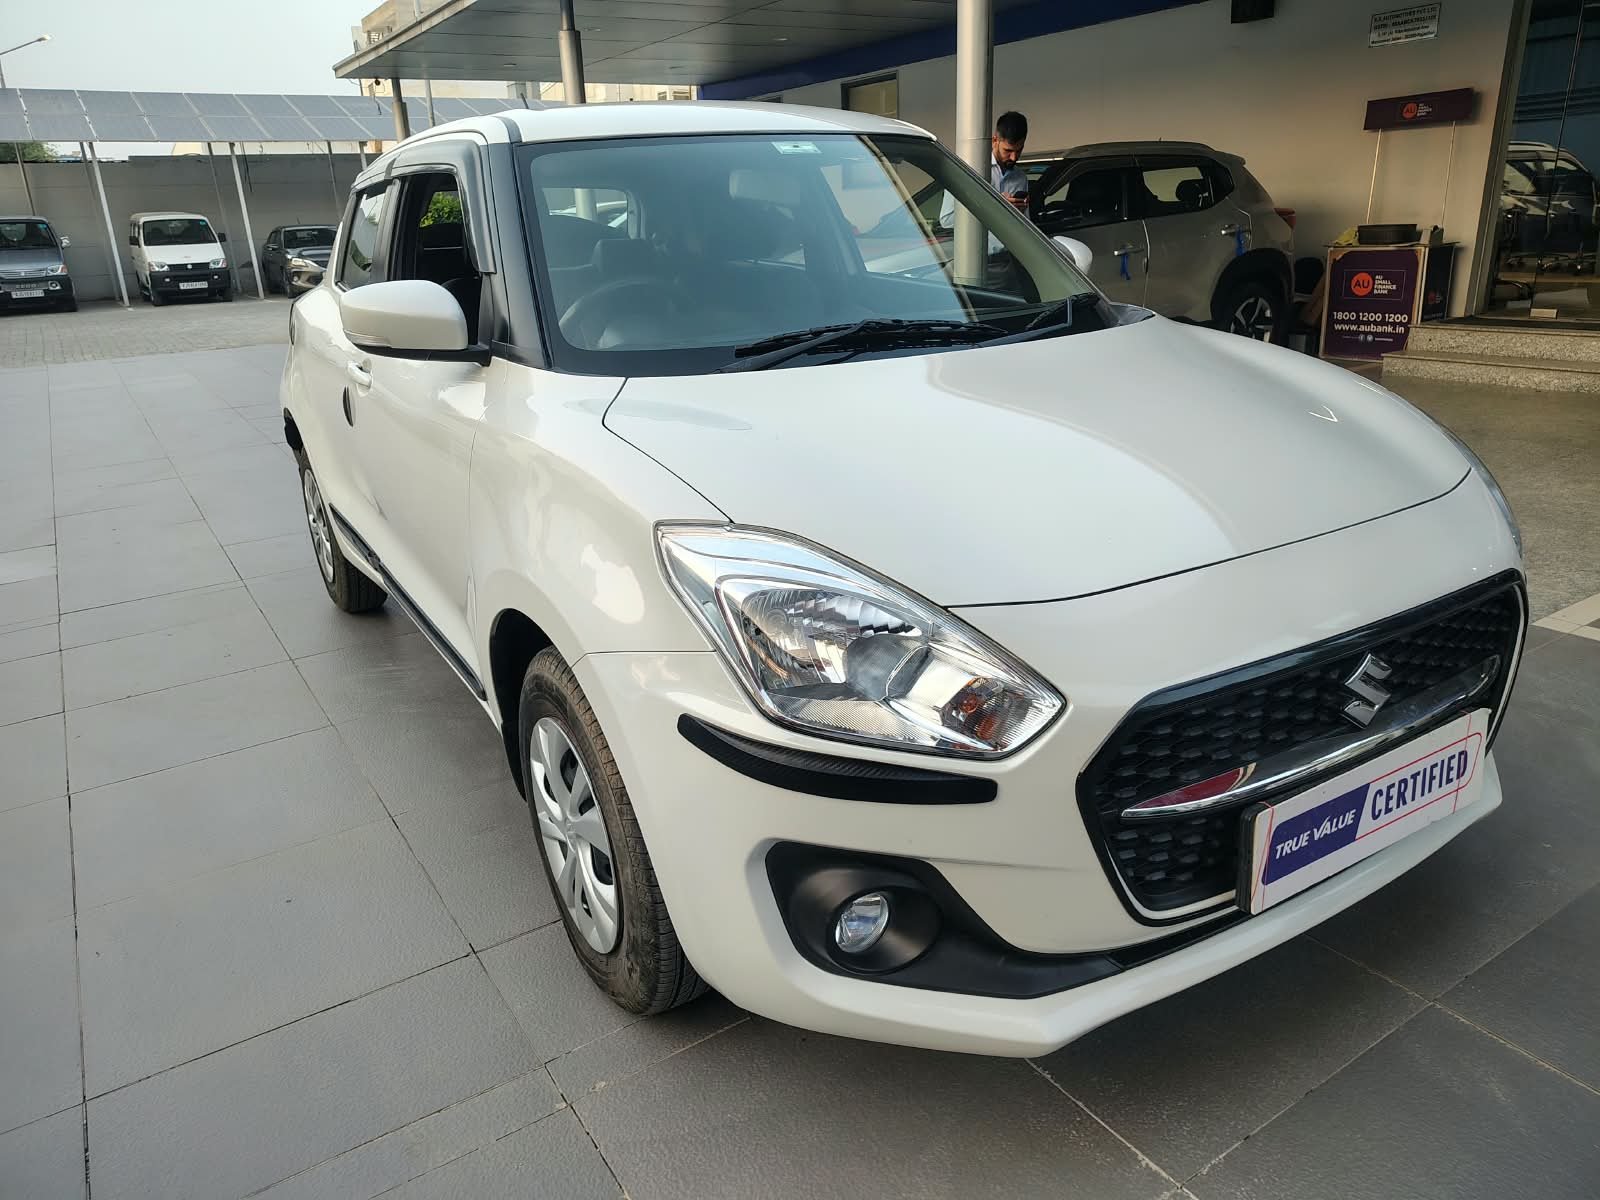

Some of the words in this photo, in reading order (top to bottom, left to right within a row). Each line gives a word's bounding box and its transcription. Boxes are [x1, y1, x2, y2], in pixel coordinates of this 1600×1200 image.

[1353, 279, 1370, 289] AU
[1333, 311, 1356, 320] 1800
[1359, 312, 1383, 322] 1200
[1385, 313, 1408, 323] 1200
[1334, 323, 1405, 334] www.aubank.in
[1275, 831, 1310, 860] TRUE
[1313, 808, 1357, 842] VALUE
[1371, 749, 1469, 821] CERTIFIED
